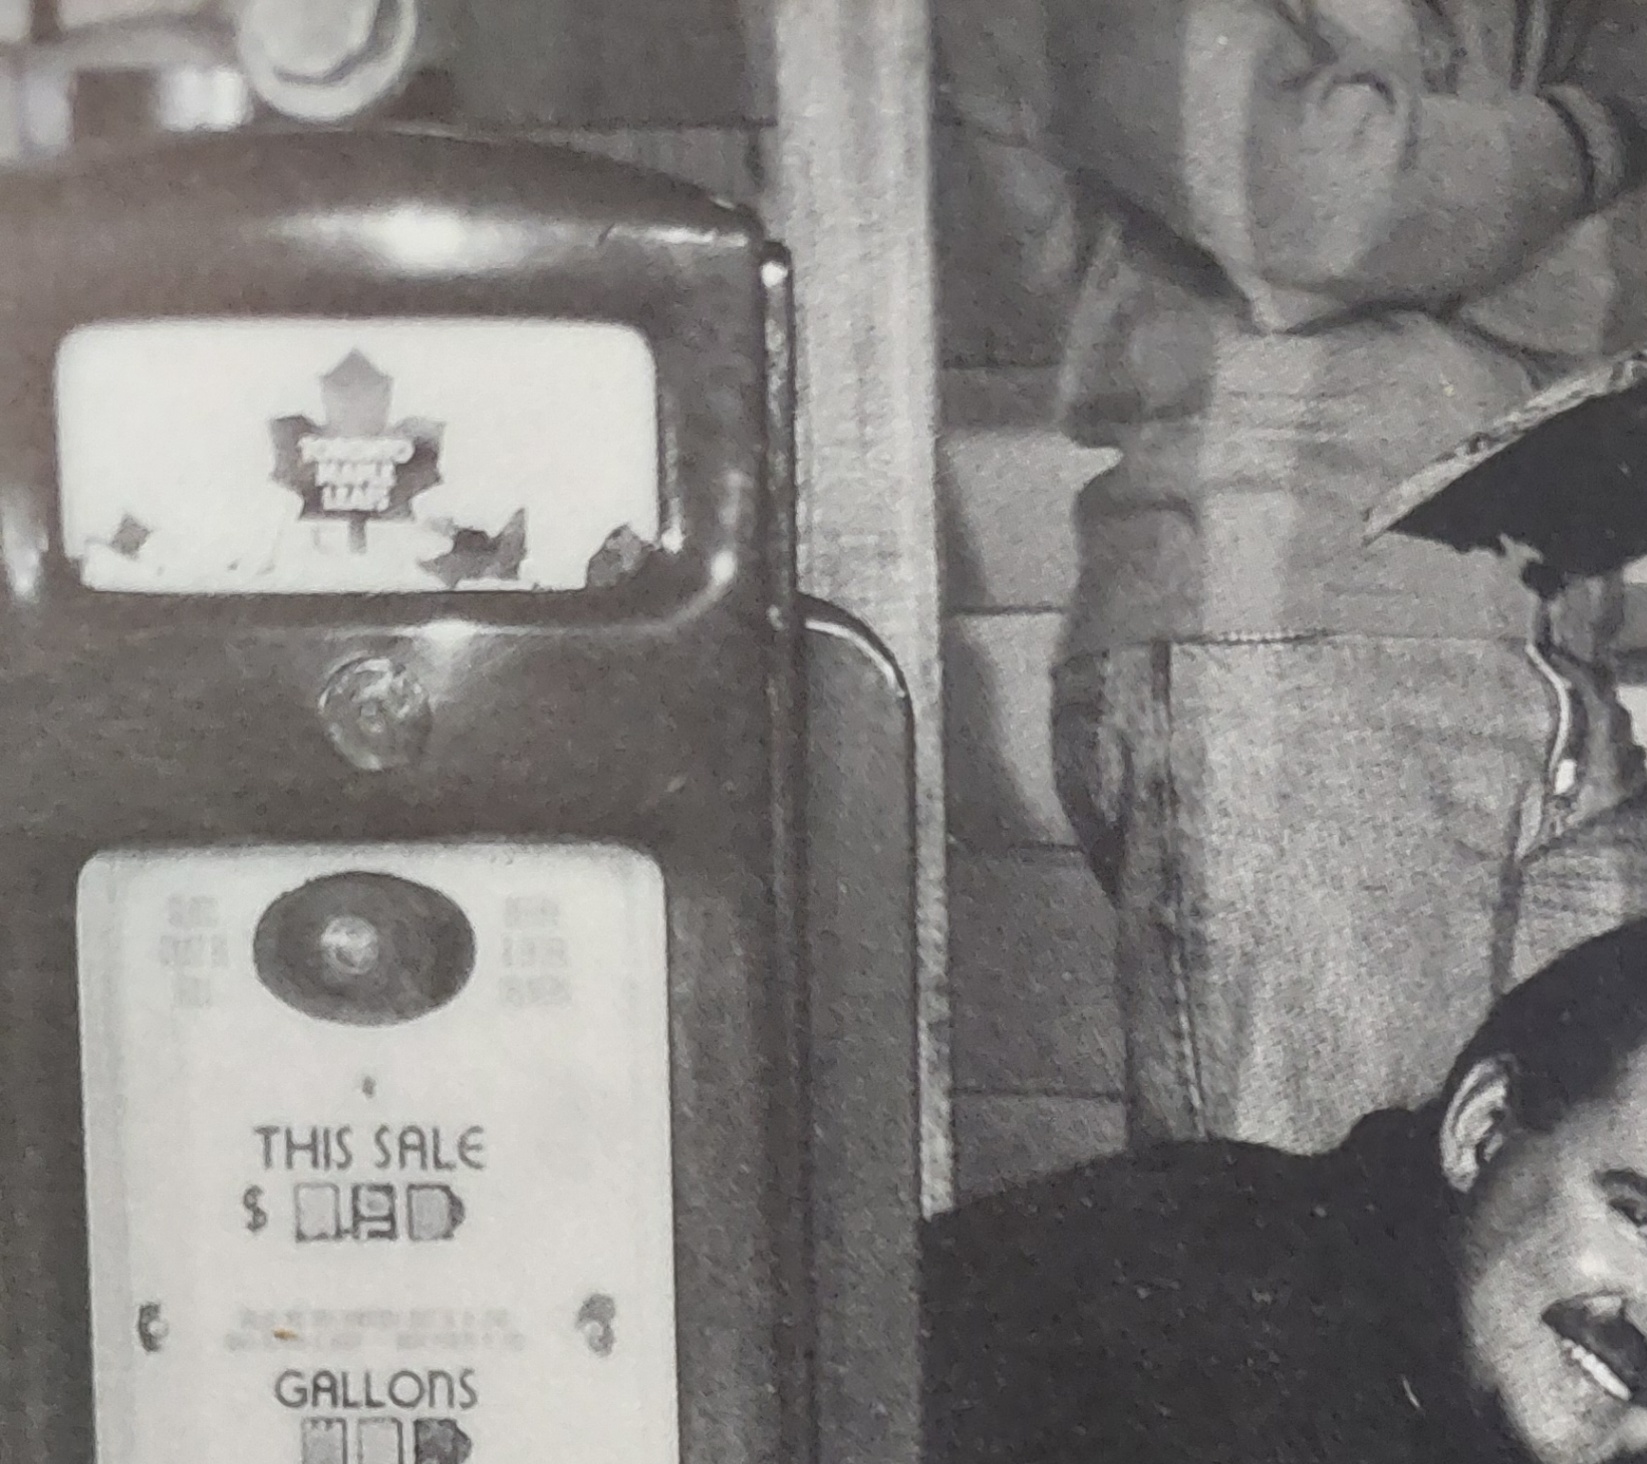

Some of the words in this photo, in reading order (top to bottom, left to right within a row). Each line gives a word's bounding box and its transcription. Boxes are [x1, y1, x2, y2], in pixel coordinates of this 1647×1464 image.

[254, 1124, 354, 1171] THIS
[374, 1124, 485, 1171] SALE
[242, 1185, 269, 1233] $
[274, 1367, 480, 1410] GALLONS
